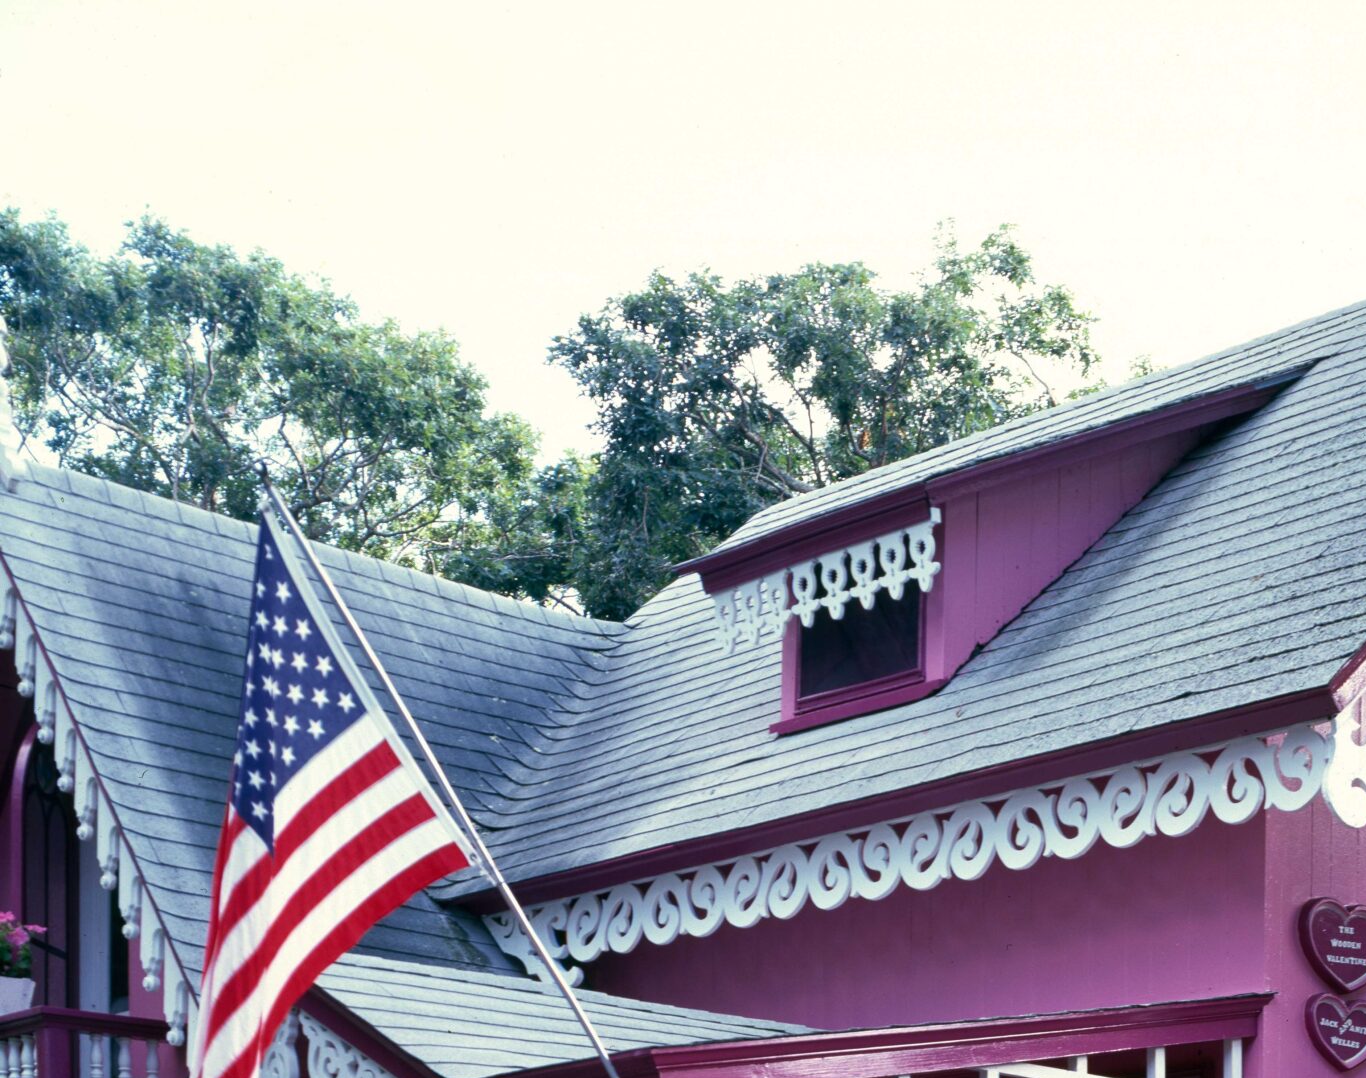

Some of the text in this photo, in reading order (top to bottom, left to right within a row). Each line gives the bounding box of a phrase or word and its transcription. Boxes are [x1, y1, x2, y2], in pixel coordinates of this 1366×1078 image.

[1338, 926, 1354, 935] THE
[1330, 938, 1361, 949] WOODEN
[1319, 1017, 1339, 1028] JACK
[1330, 1035, 1360, 1048] WELLES
